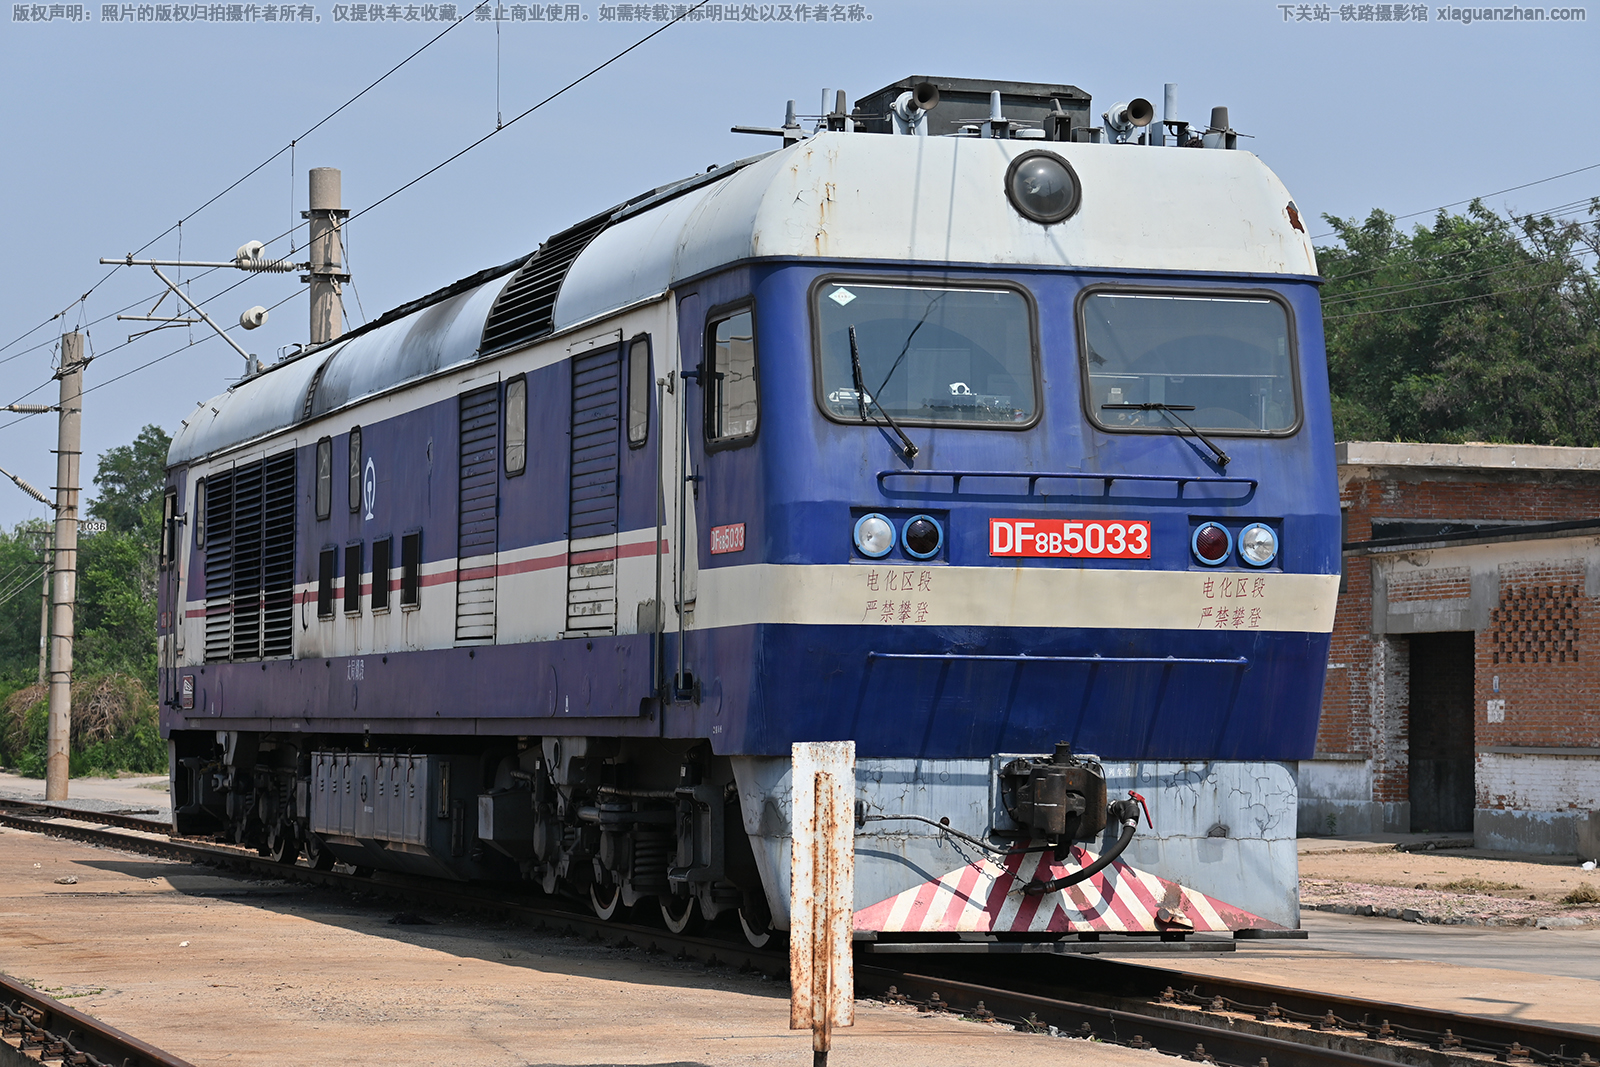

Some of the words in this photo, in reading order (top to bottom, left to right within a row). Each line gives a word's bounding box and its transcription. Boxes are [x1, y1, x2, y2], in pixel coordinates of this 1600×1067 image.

[993, 521, 1148, 554] DF8B5033
[867, 569, 932, 591] 电化区段
[1203, 577, 1265, 598] 电化区段
[862, 600, 928, 623] 严禁攀登
[1197, 606, 1261, 628] 严禁攀登
